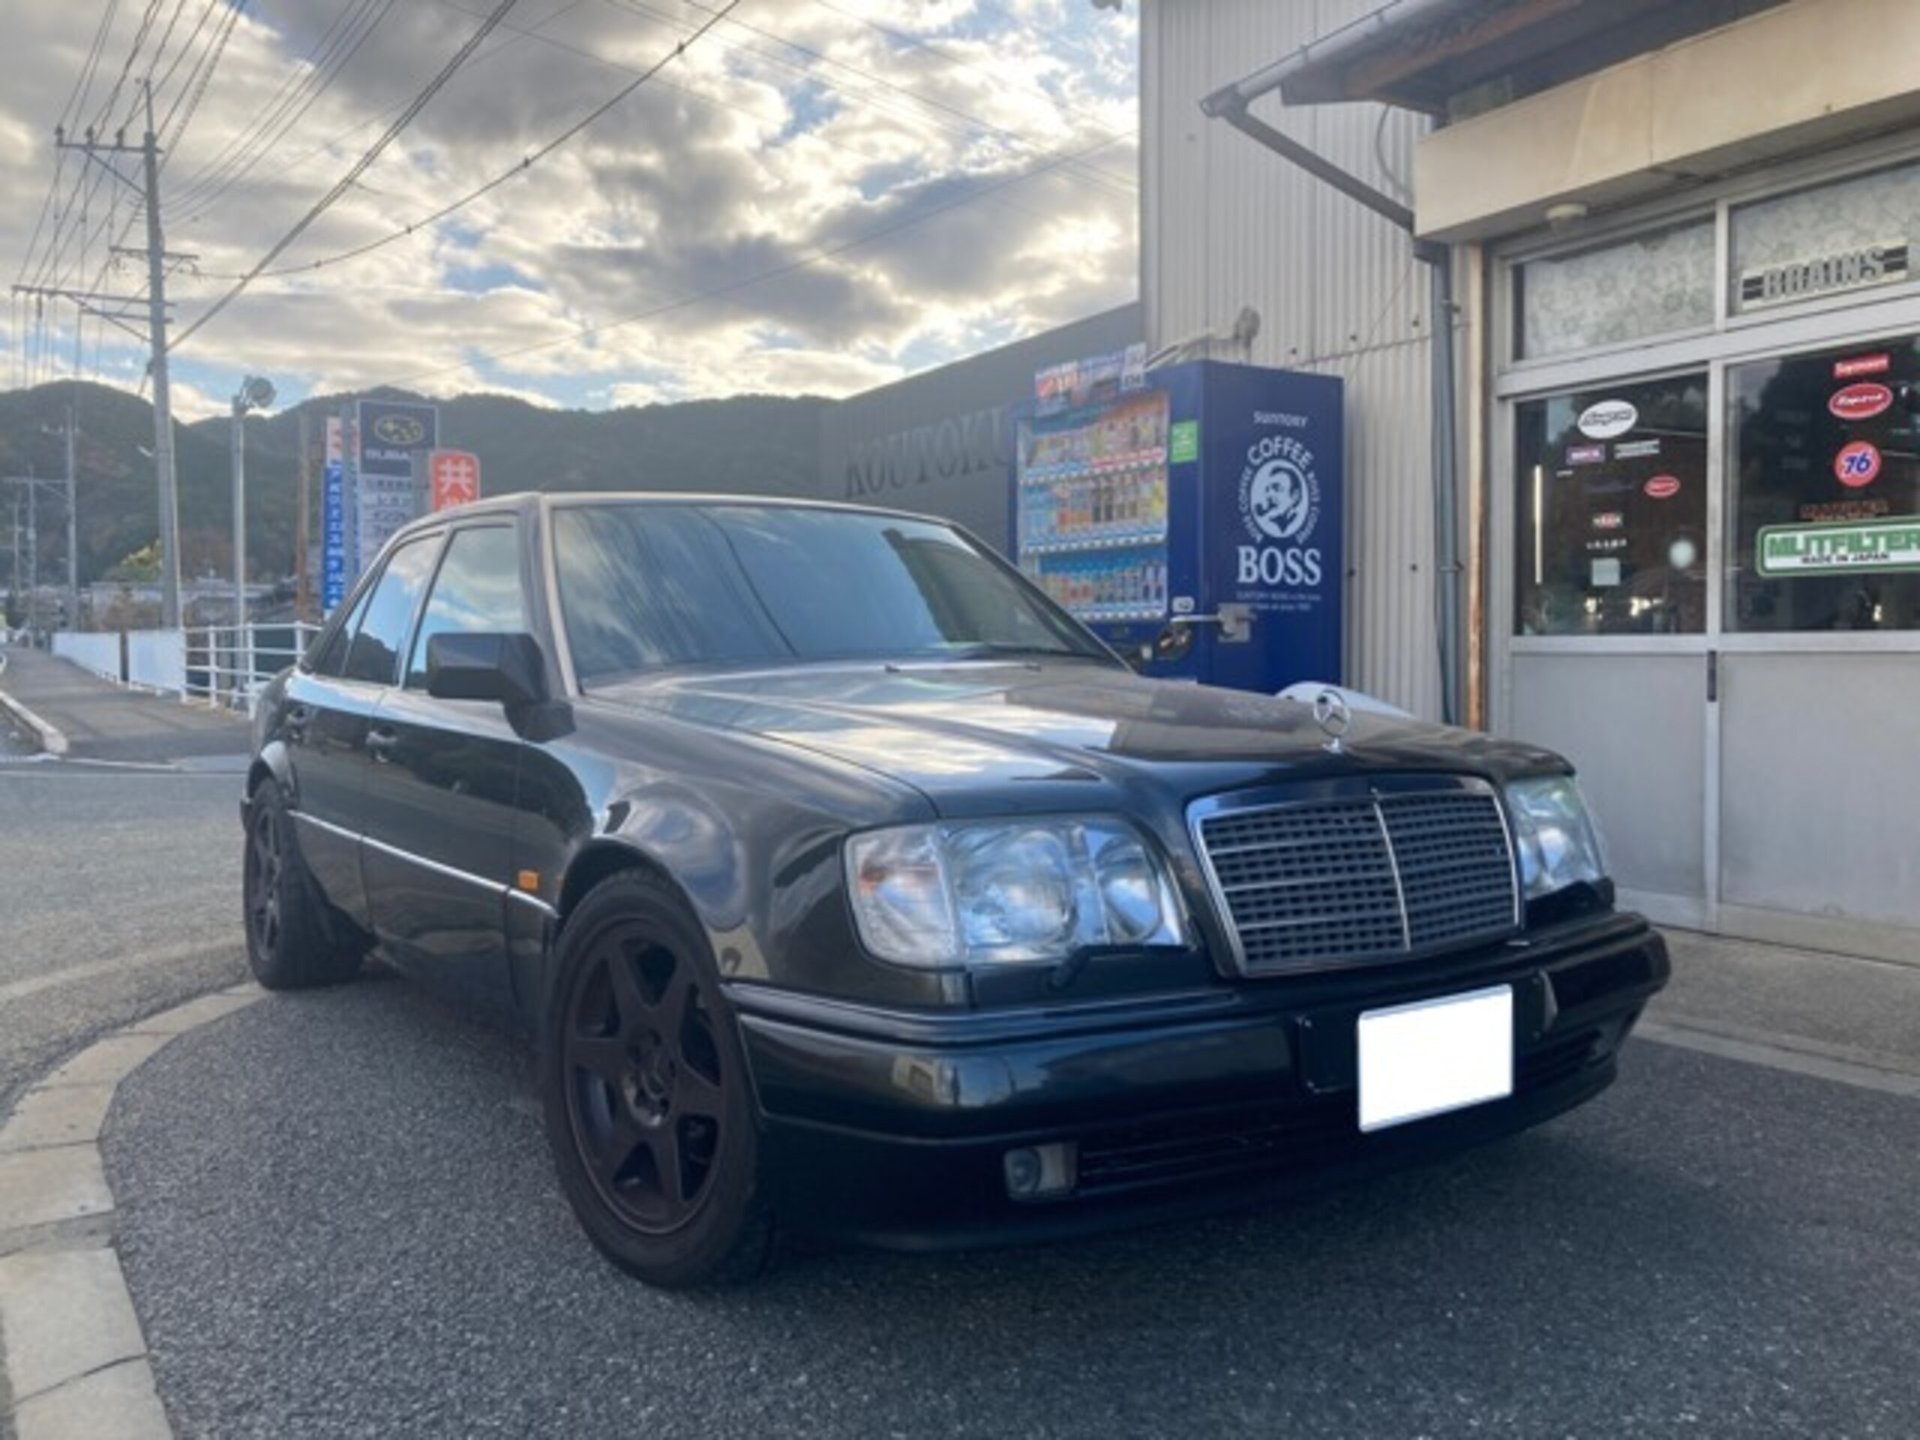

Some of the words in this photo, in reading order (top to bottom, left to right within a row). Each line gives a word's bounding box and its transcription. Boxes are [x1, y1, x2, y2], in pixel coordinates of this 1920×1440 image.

[1764, 246, 1885, 299] BRAINS
[1247, 435, 1314, 470] COFFEE
[1844, 453, 1871, 474] 76
[437, 458, 474, 508] 共
[1237, 545, 1321, 586] BOSS
[1802, 555, 1832, 564] MADE
[1836, 553, 1848, 562] IN
[1851, 552, 1889, 562] JAPAN
